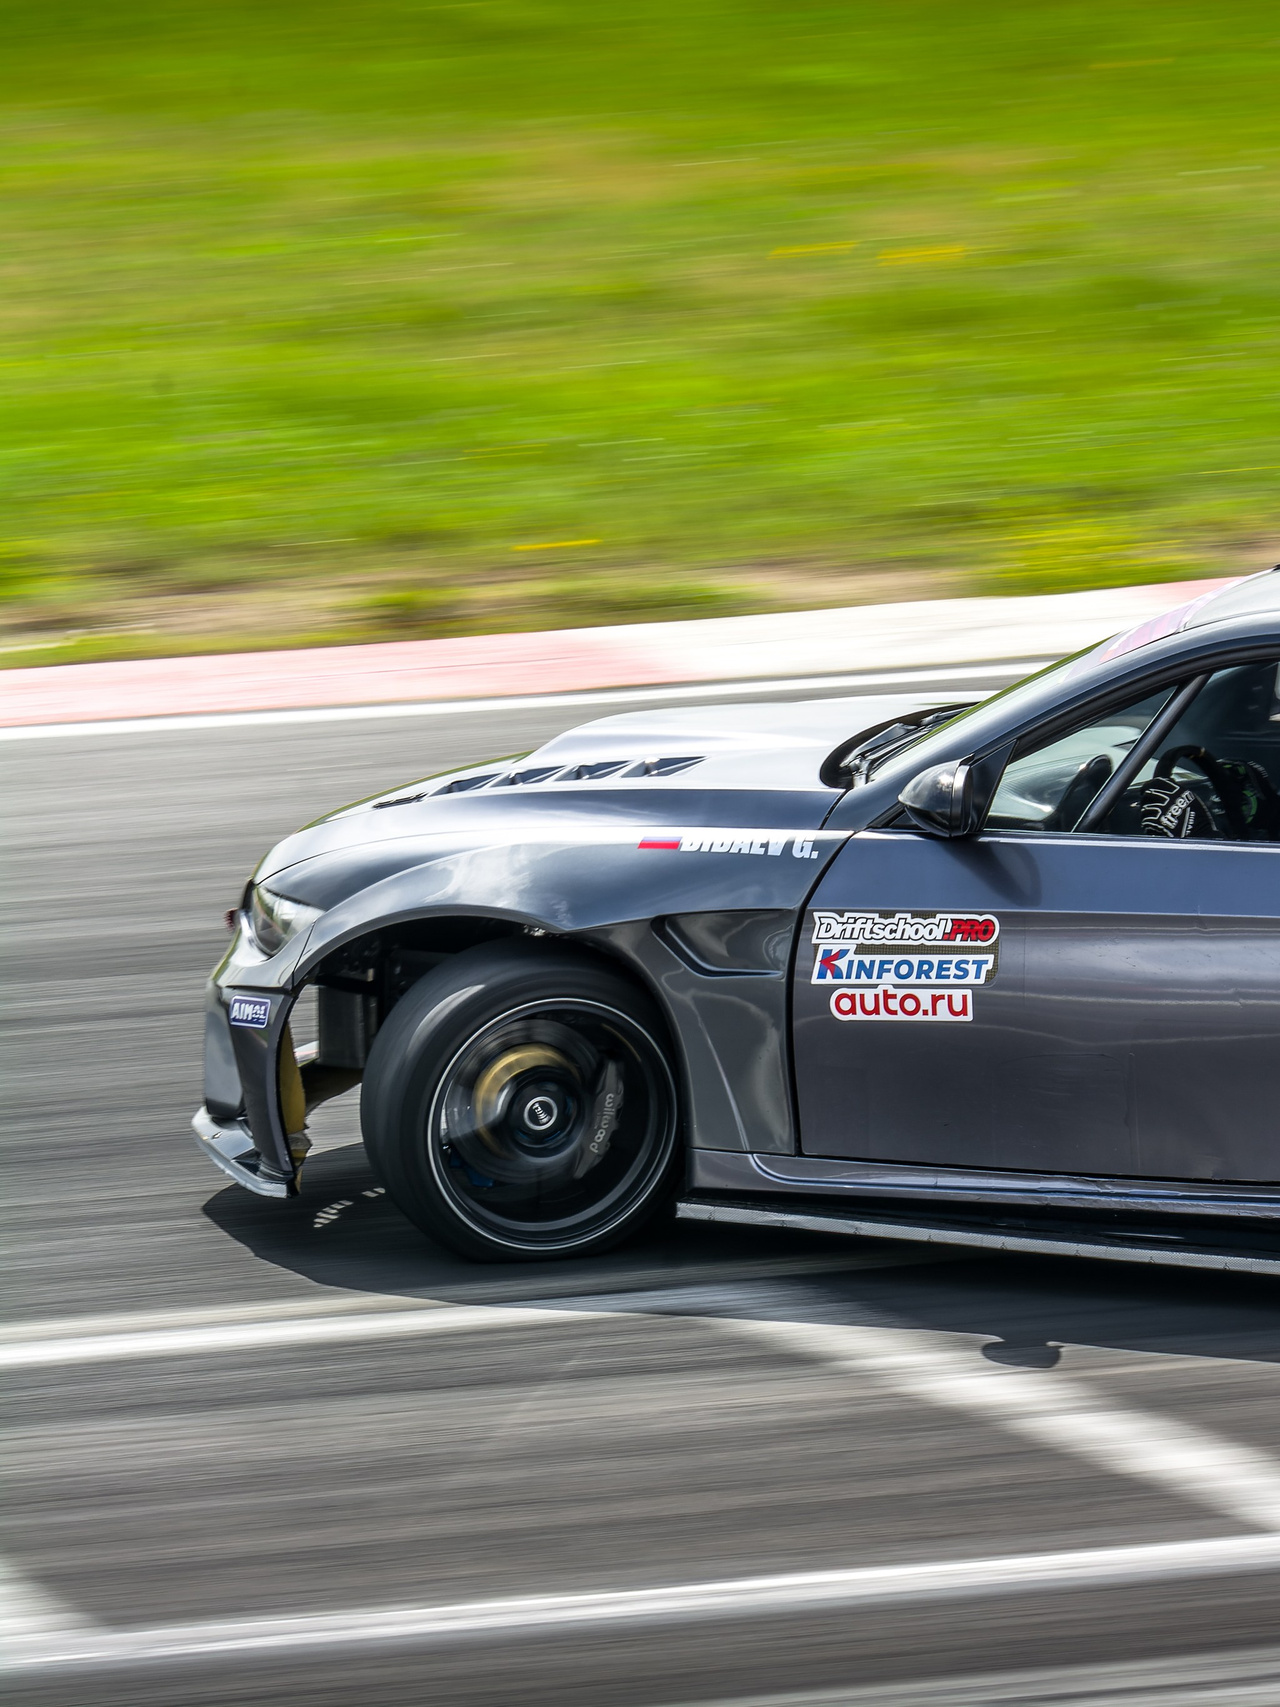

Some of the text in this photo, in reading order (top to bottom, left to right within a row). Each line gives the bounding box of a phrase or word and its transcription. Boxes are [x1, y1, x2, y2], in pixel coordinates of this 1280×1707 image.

[792, 833, 819, 859] G.
[817, 948, 989, 980] KINFOREST
[834, 989, 968, 1017] auto.ru
